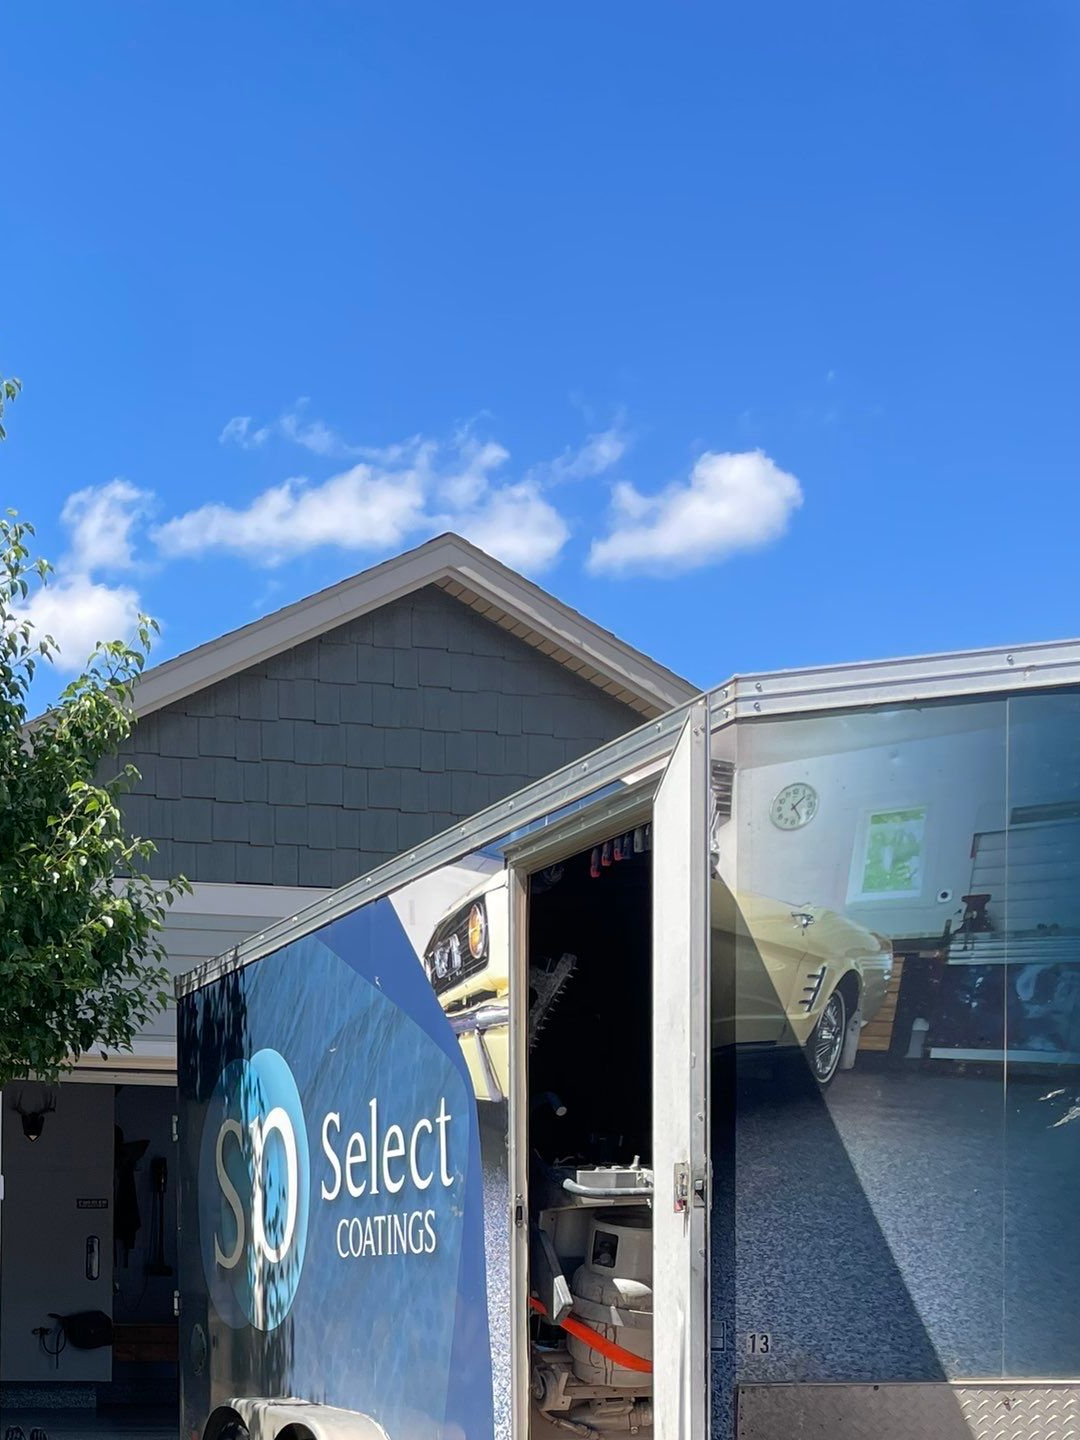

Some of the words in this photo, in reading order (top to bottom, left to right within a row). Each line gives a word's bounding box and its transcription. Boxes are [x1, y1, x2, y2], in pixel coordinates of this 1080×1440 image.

[320, 1096, 455, 1200] Select
[336, 1209, 437, 1259] COATINGS
[748, 1333, 769, 1354] 13
